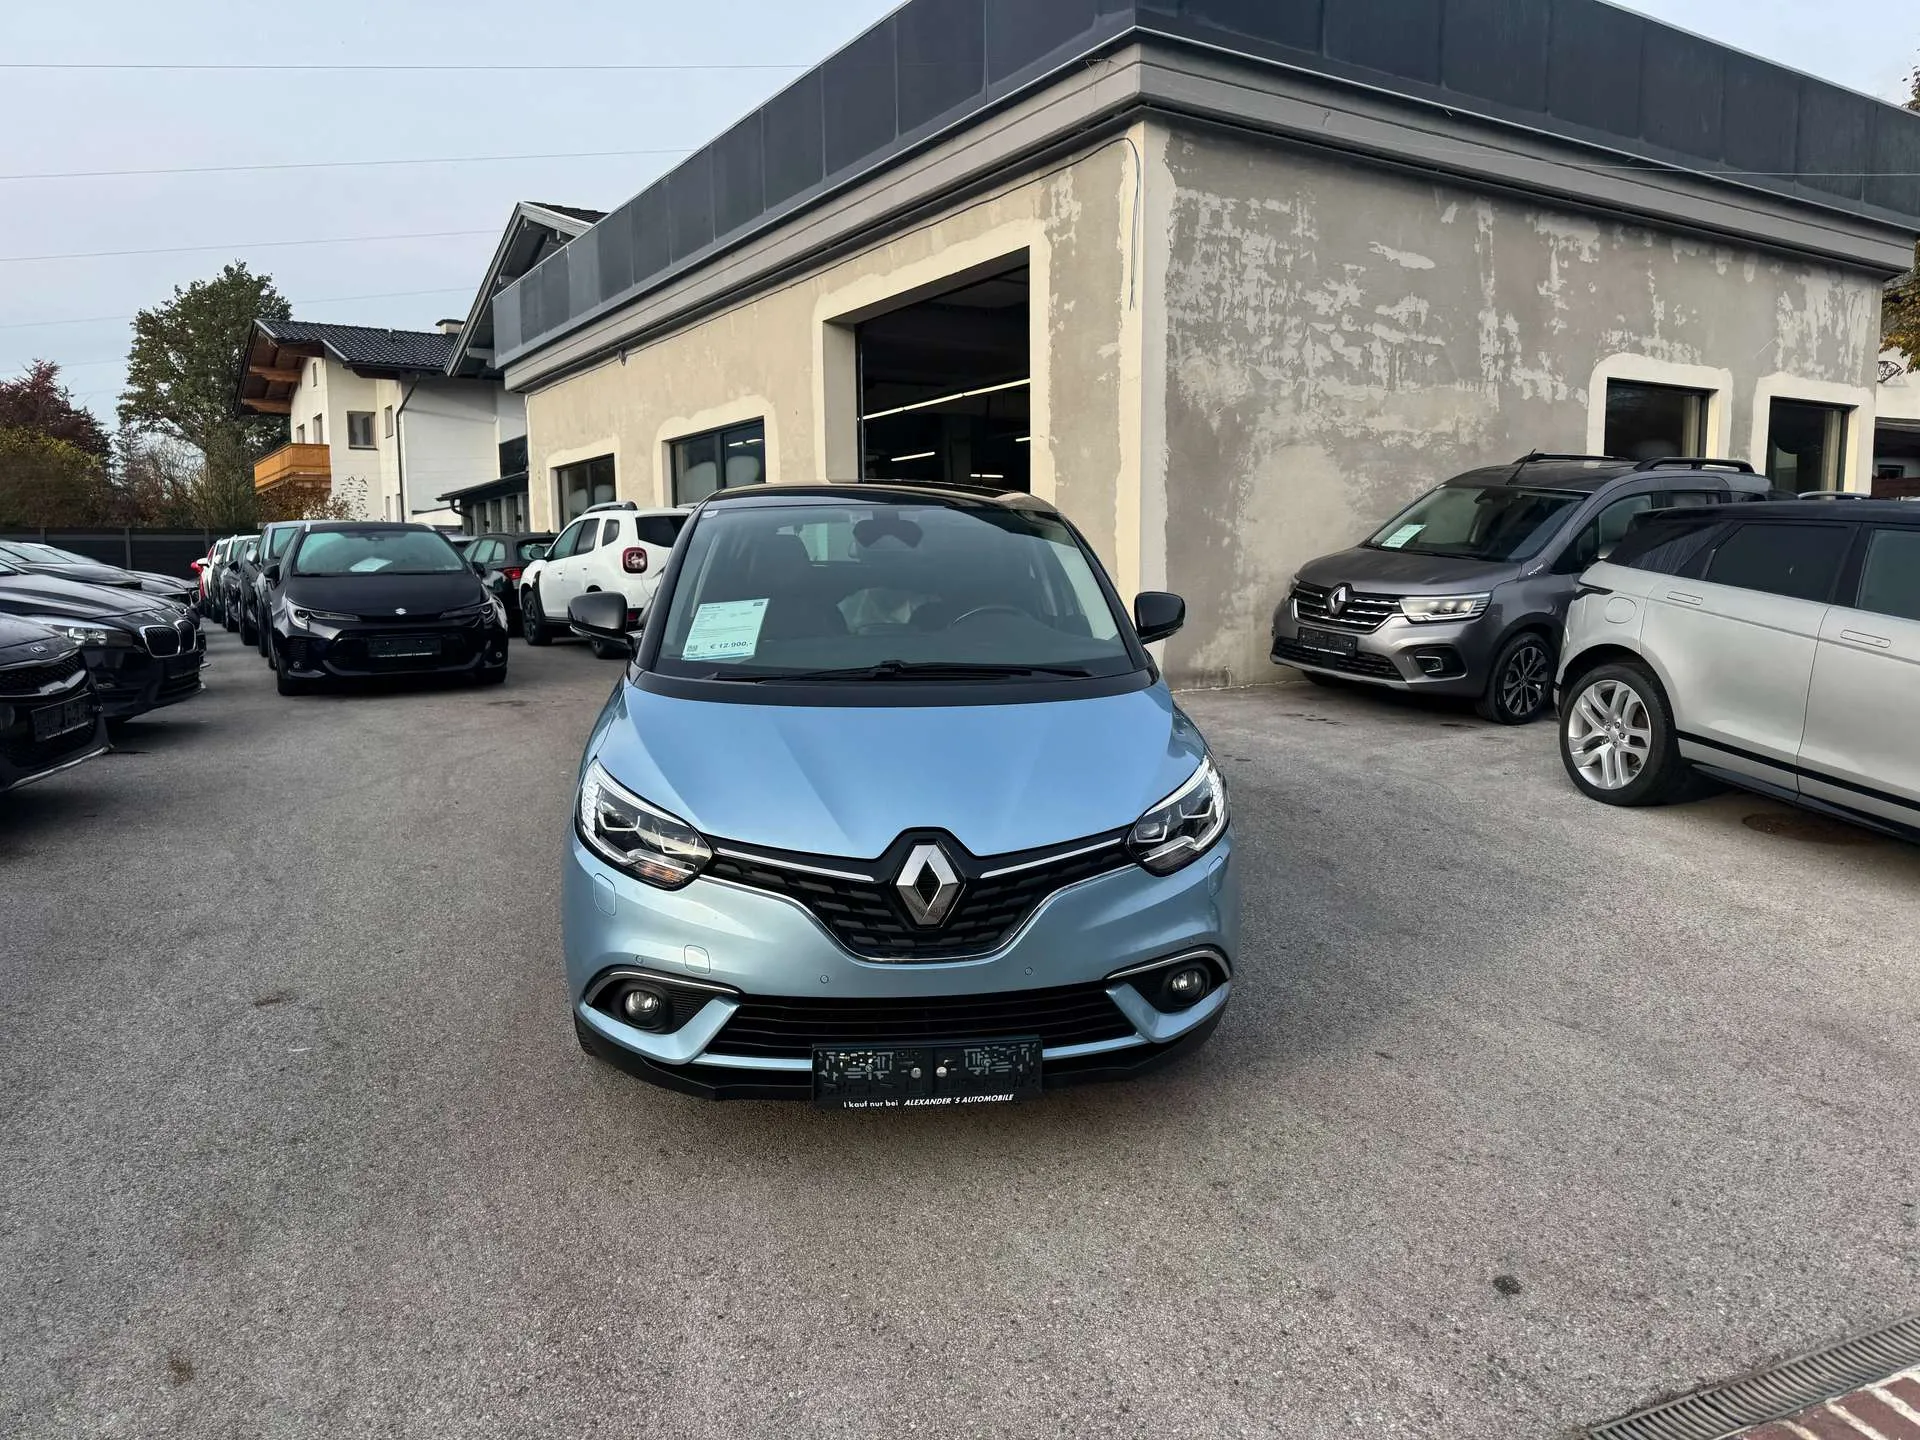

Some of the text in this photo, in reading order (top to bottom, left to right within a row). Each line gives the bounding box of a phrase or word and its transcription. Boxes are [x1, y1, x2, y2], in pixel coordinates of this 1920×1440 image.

[848, 1100, 868, 1108] kauf
[885, 1099, 899, 1107] bei
[904, 1097, 951, 1106] ALEXANDER
[961, 1094, 1014, 1104] AUTOMOBILE
